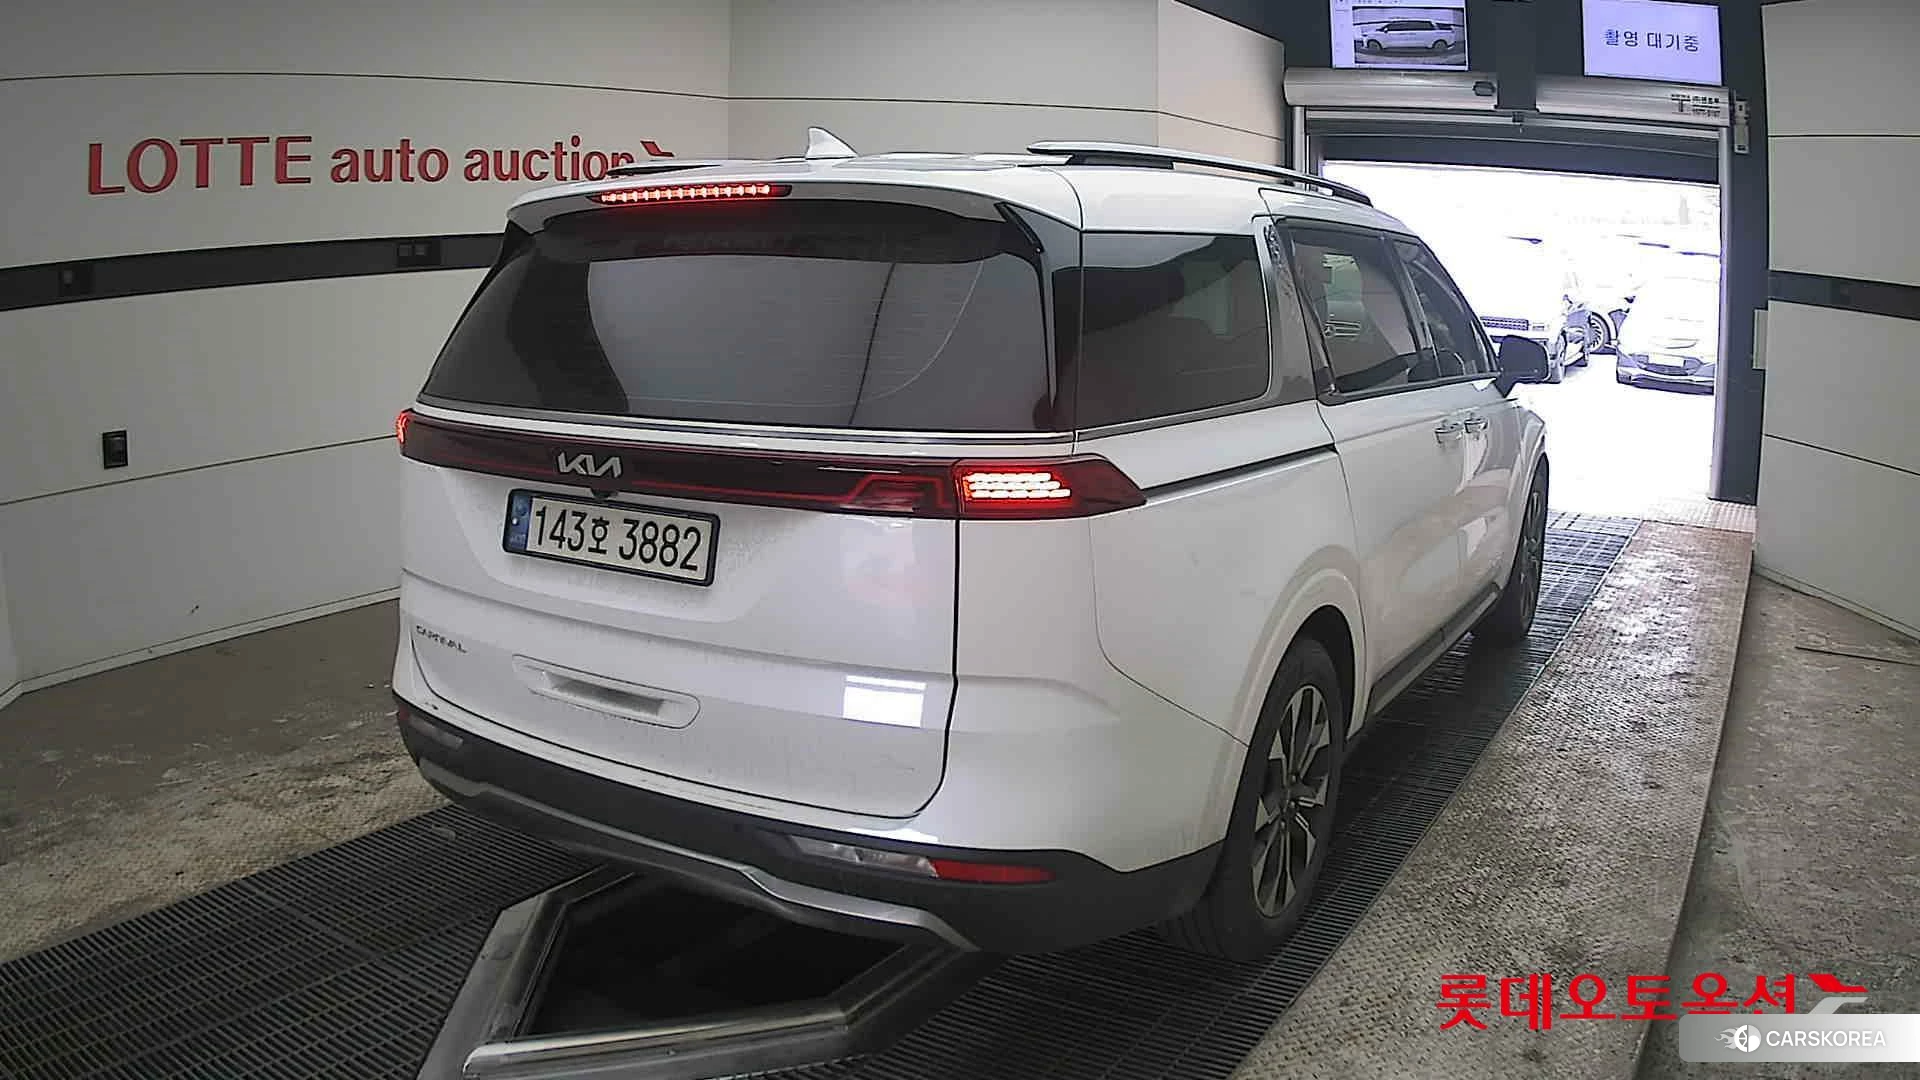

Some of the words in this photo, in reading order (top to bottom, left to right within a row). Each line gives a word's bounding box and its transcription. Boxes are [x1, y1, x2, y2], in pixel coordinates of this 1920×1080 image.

[1647, 32, 1698, 52] 대기중
[88, 136, 312, 194] LOTTE
[330, 137, 449, 183] auto
[557, 452, 623, 478] KIA
[536, 505, 609, 554] 143호
[619, 518, 701, 571] 3882
